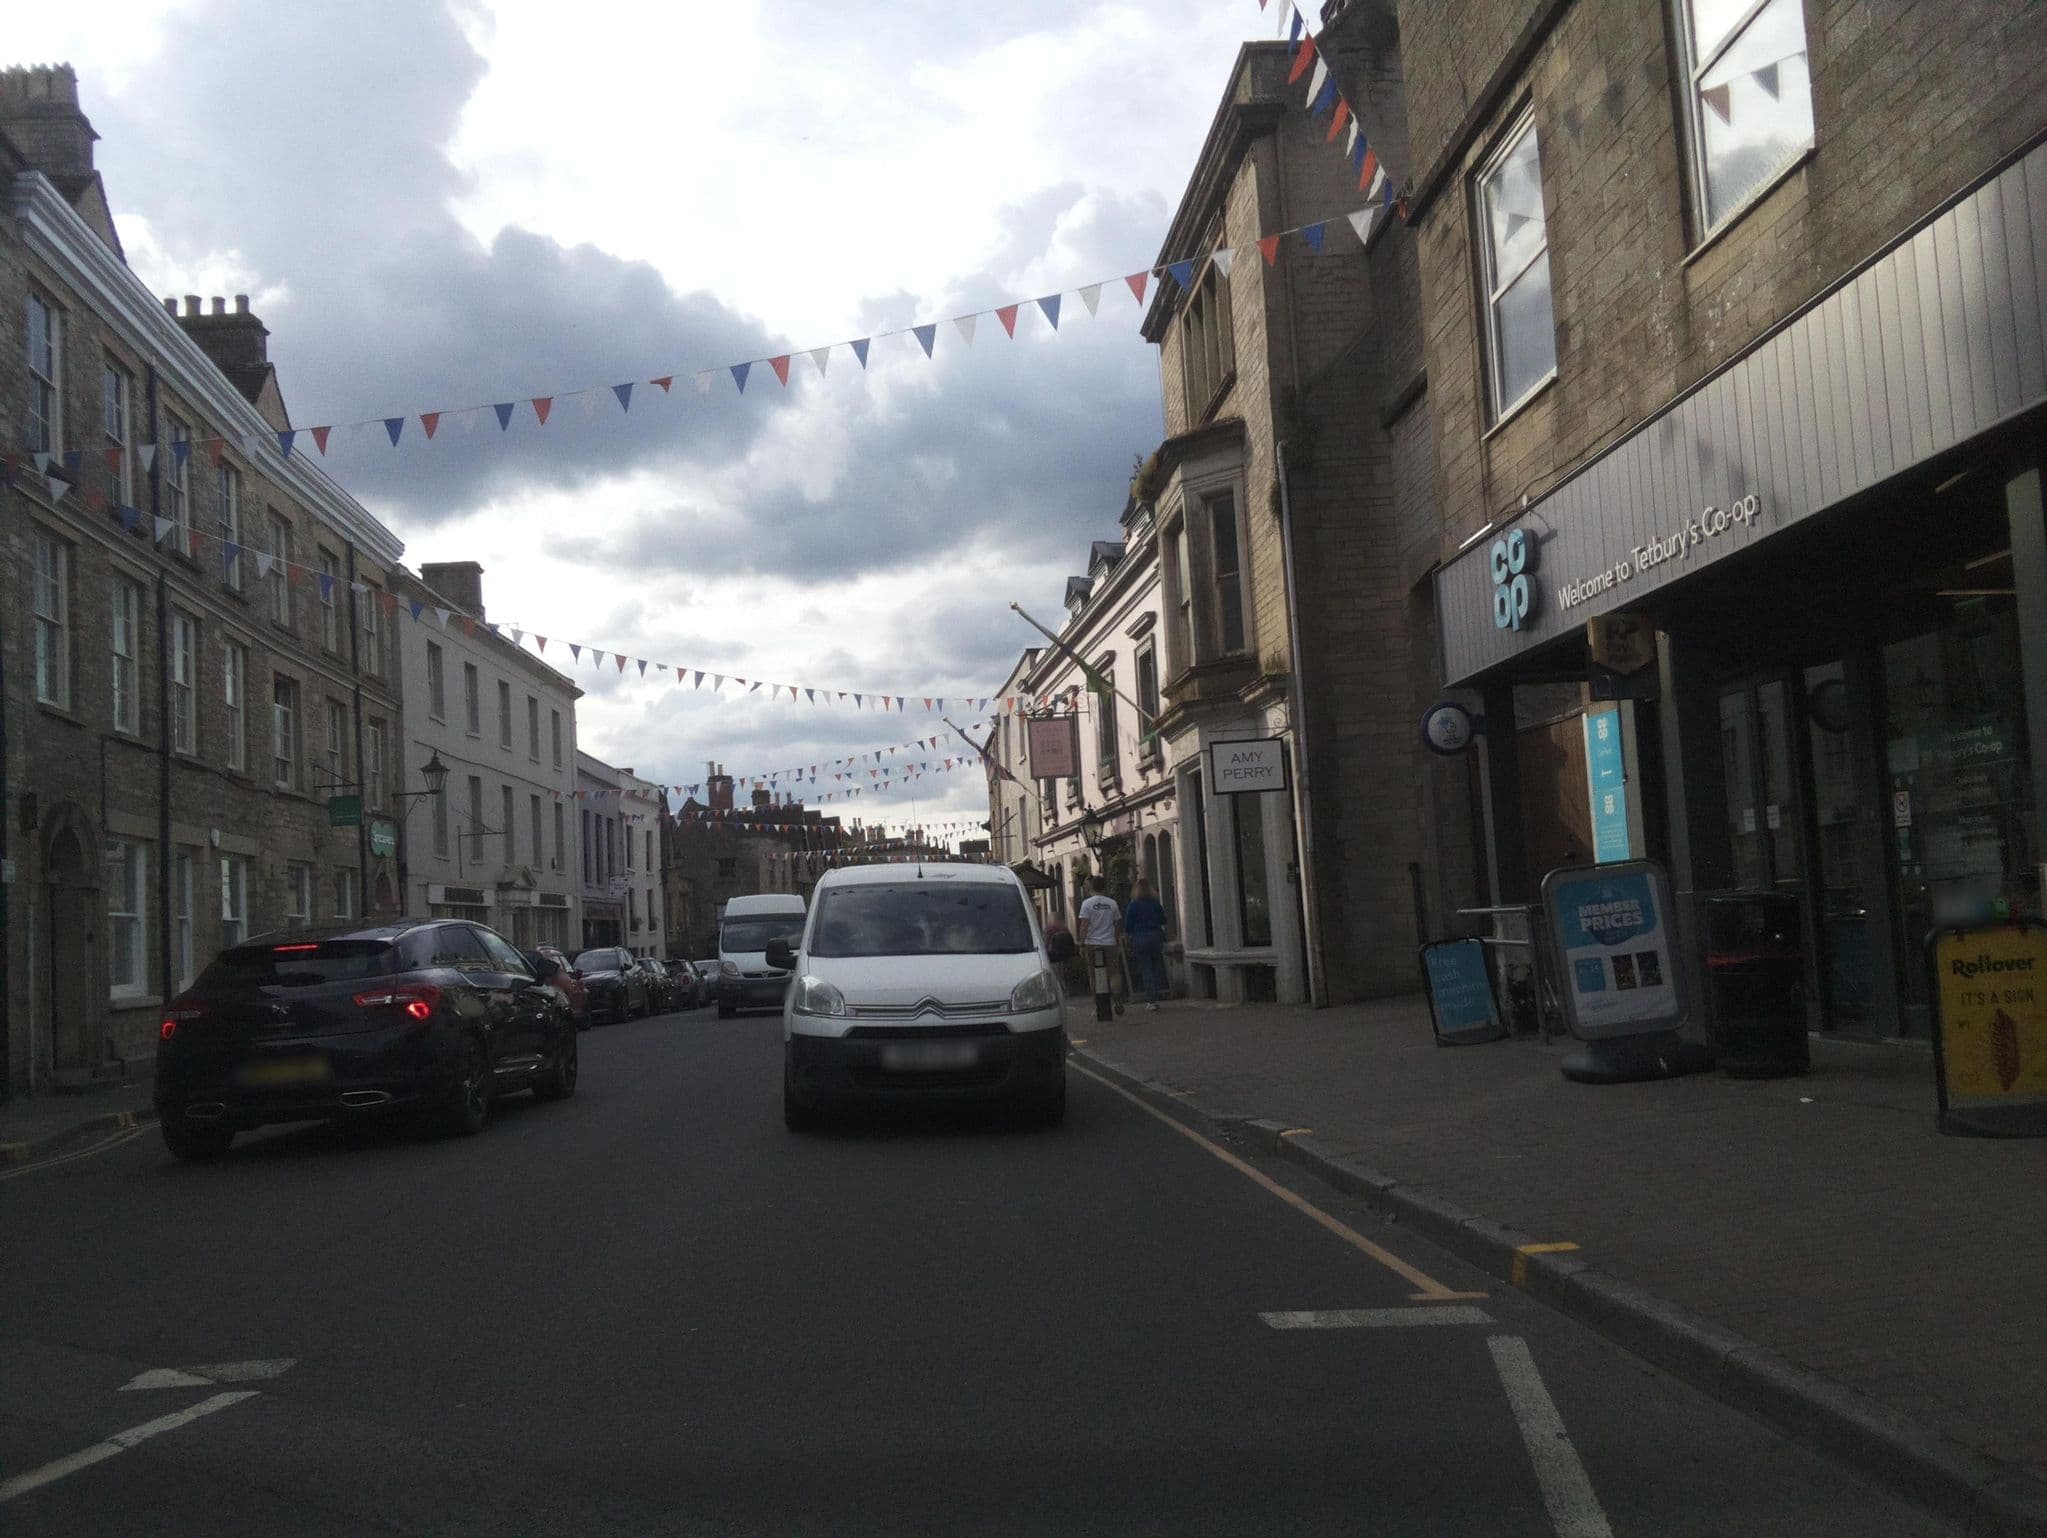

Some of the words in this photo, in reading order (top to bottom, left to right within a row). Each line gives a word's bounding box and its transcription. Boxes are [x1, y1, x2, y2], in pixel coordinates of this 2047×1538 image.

[1558, 568, 1613, 611] Welcome
[1615, 561, 1629, 582] to
[1631, 519, 1698, 573] Tetbury's
[1701, 494, 1756, 537] Co-op
[1232, 752, 1262, 763] AMY
[1223, 766, 1273, 780] PERRY
[1578, 900, 1641, 917] MEMBER
[1580, 912, 1644, 931] PRICES
[1951, 955, 2036, 978] Rollover
[1961, 991, 1985, 1006] IT'S
[1991, 990, 2000, 1004] A
